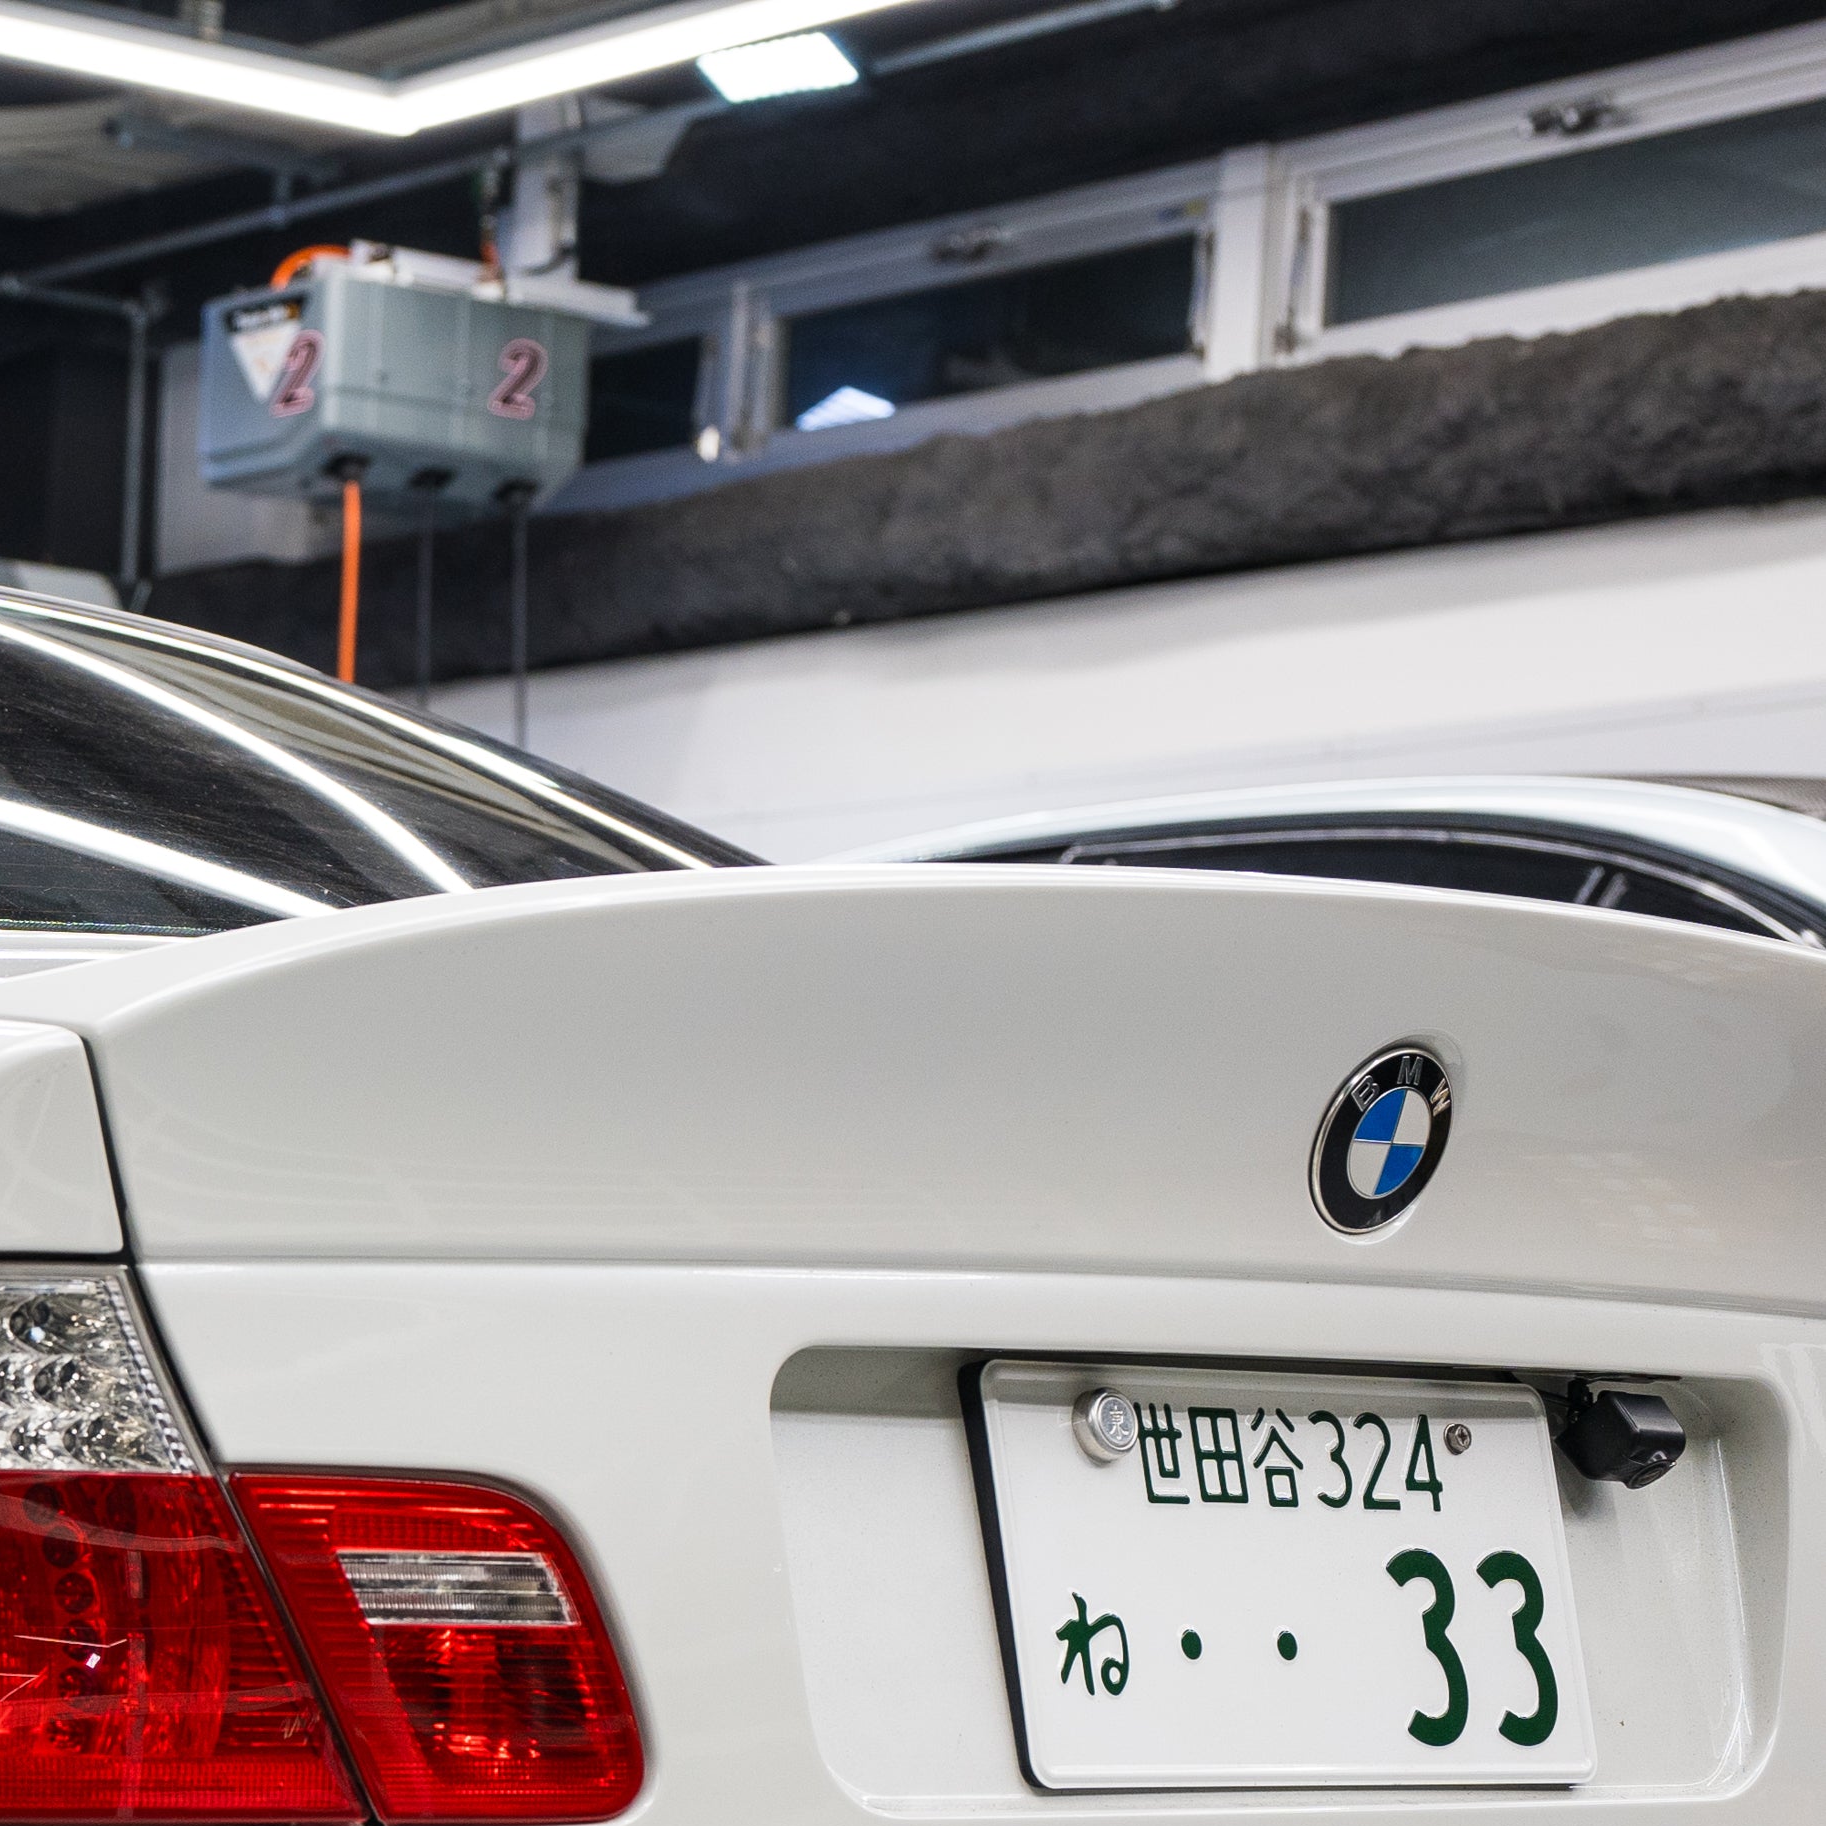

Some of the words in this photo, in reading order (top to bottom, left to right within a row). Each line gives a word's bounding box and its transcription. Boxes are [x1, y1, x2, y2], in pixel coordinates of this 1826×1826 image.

[270, 329, 325, 418] 2
[487, 338, 548, 420] 2
[1351, 1055, 1451, 1117] BMW
[1056, 1591, 1130, 1696] ね
[1385, 1548, 1559, 1747] 33
